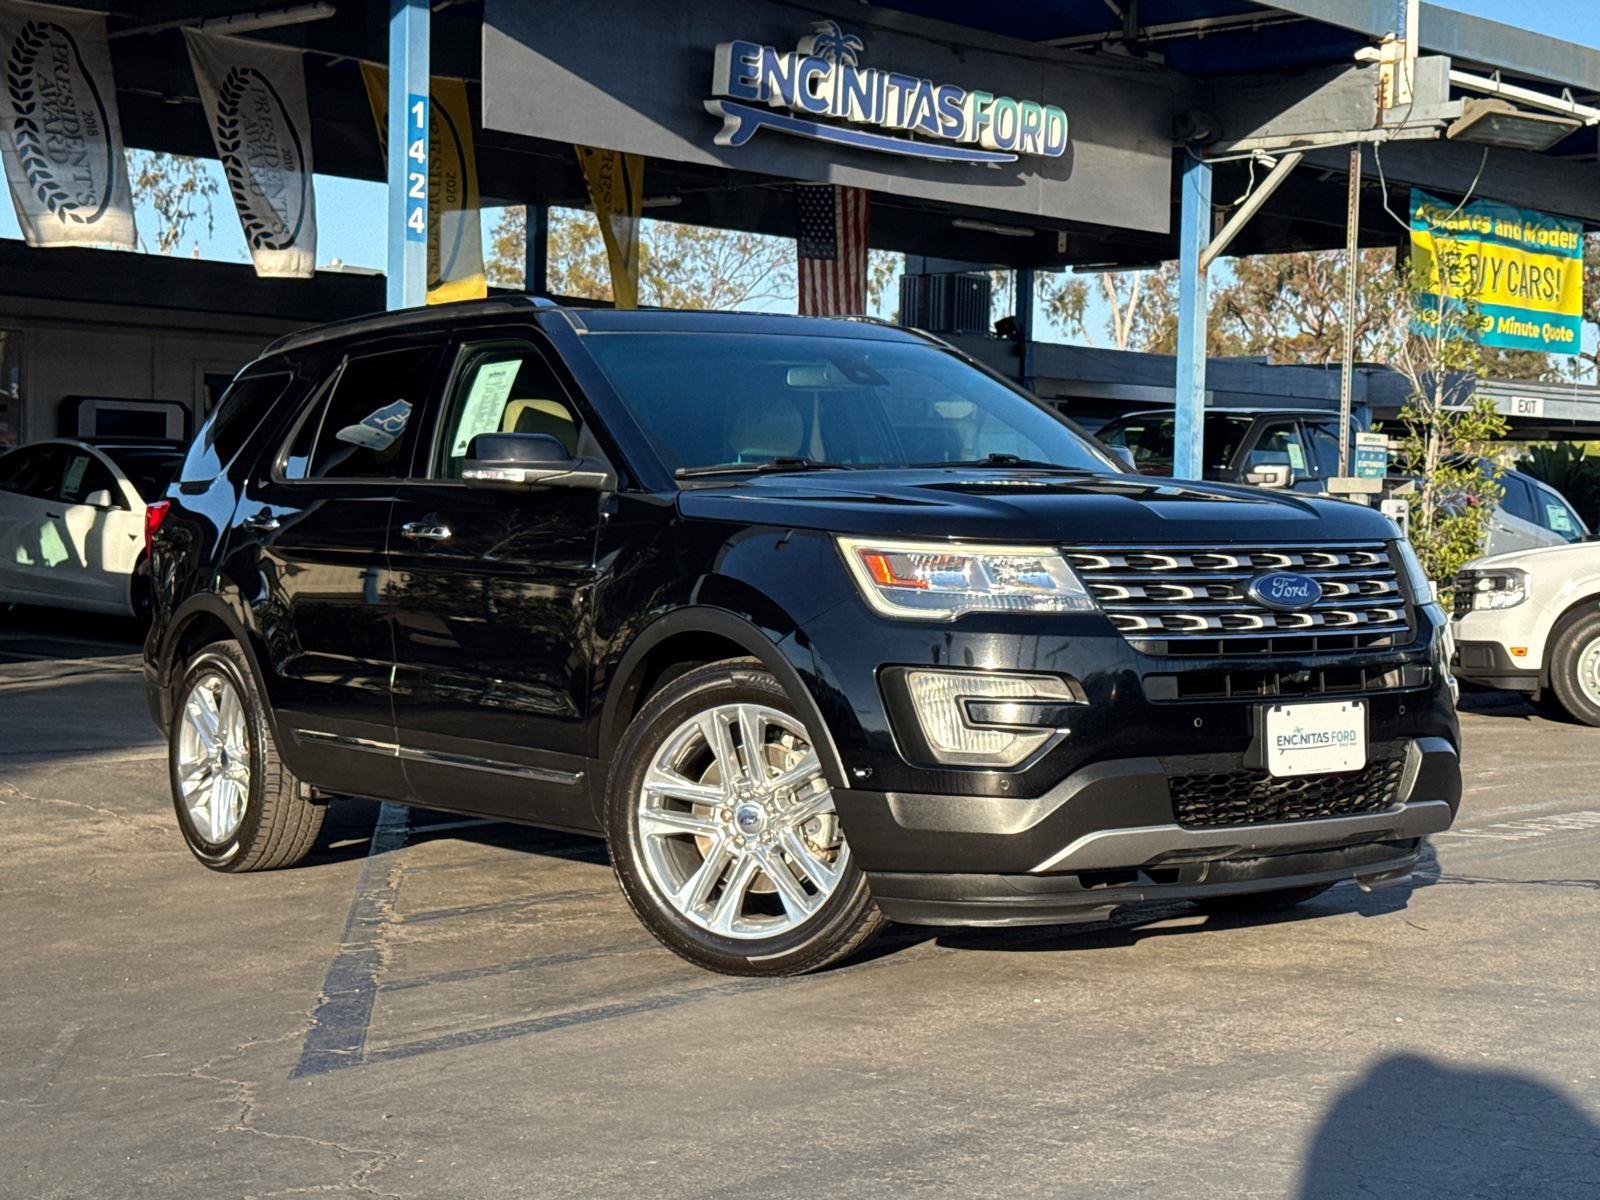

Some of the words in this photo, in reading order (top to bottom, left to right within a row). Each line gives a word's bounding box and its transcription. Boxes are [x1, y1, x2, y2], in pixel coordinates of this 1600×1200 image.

[37, 72, 69, 165] AWARD
[712, 37, 968, 141] ENCINITAS
[965, 90, 1069, 158] FORD
[49, 42, 97, 207] PRESIDENT'S
[81, 110, 99, 137] 2018
[242, 114, 266, 197] AWARD
[251, 87, 290, 235] PRESIDENT'S
[408, 100, 426, 234] 1424
[446, 171, 457, 204] 2020
[1507, 260, 1561, 303] CARS!
[1497, 316, 1540, 339] Minute
[1542, 323, 1575, 344] Quote
[1518, 399, 1537, 414] EXIT
[1271, 576, 1309, 598] Ford
[1331, 730, 1356, 743] FORD
